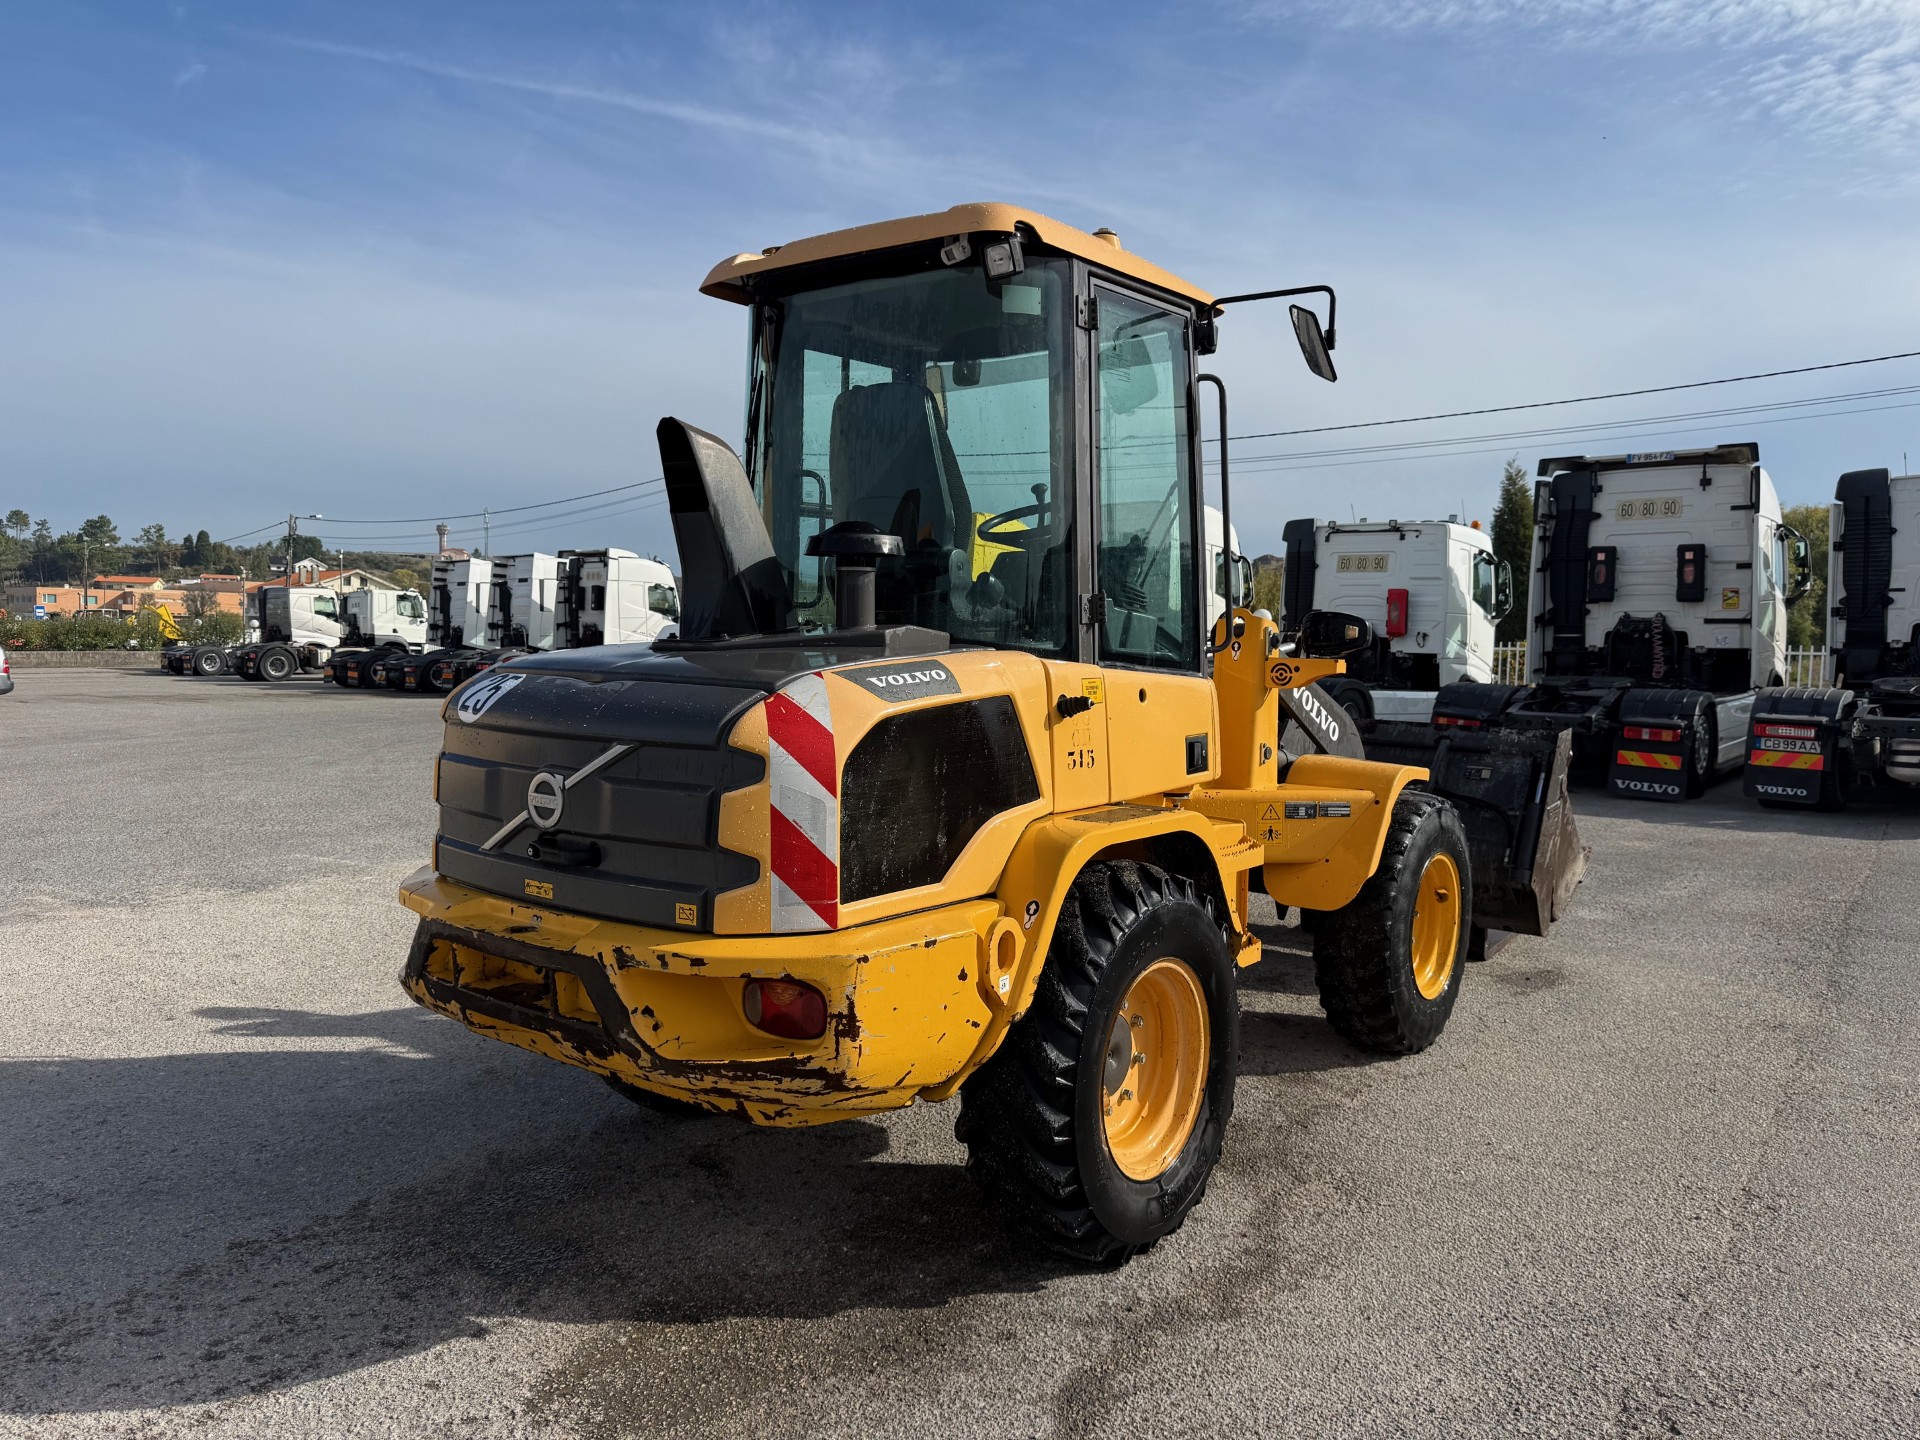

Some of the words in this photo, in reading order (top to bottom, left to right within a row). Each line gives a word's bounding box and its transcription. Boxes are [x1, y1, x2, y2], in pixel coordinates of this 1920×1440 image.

[1621, 503, 1633, 517] 60
[1642, 502, 1655, 516] 80
[1663, 501, 1676, 515] 90
[1340, 558, 1351, 570] 60
[1357, 557, 1367, 570] 80
[1374, 557, 1384, 569] 90
[866, 669, 947, 688] VOLVO
[1615, 779, 1680, 795] VOLVO
[1755, 784, 1807, 797] VOLVO
